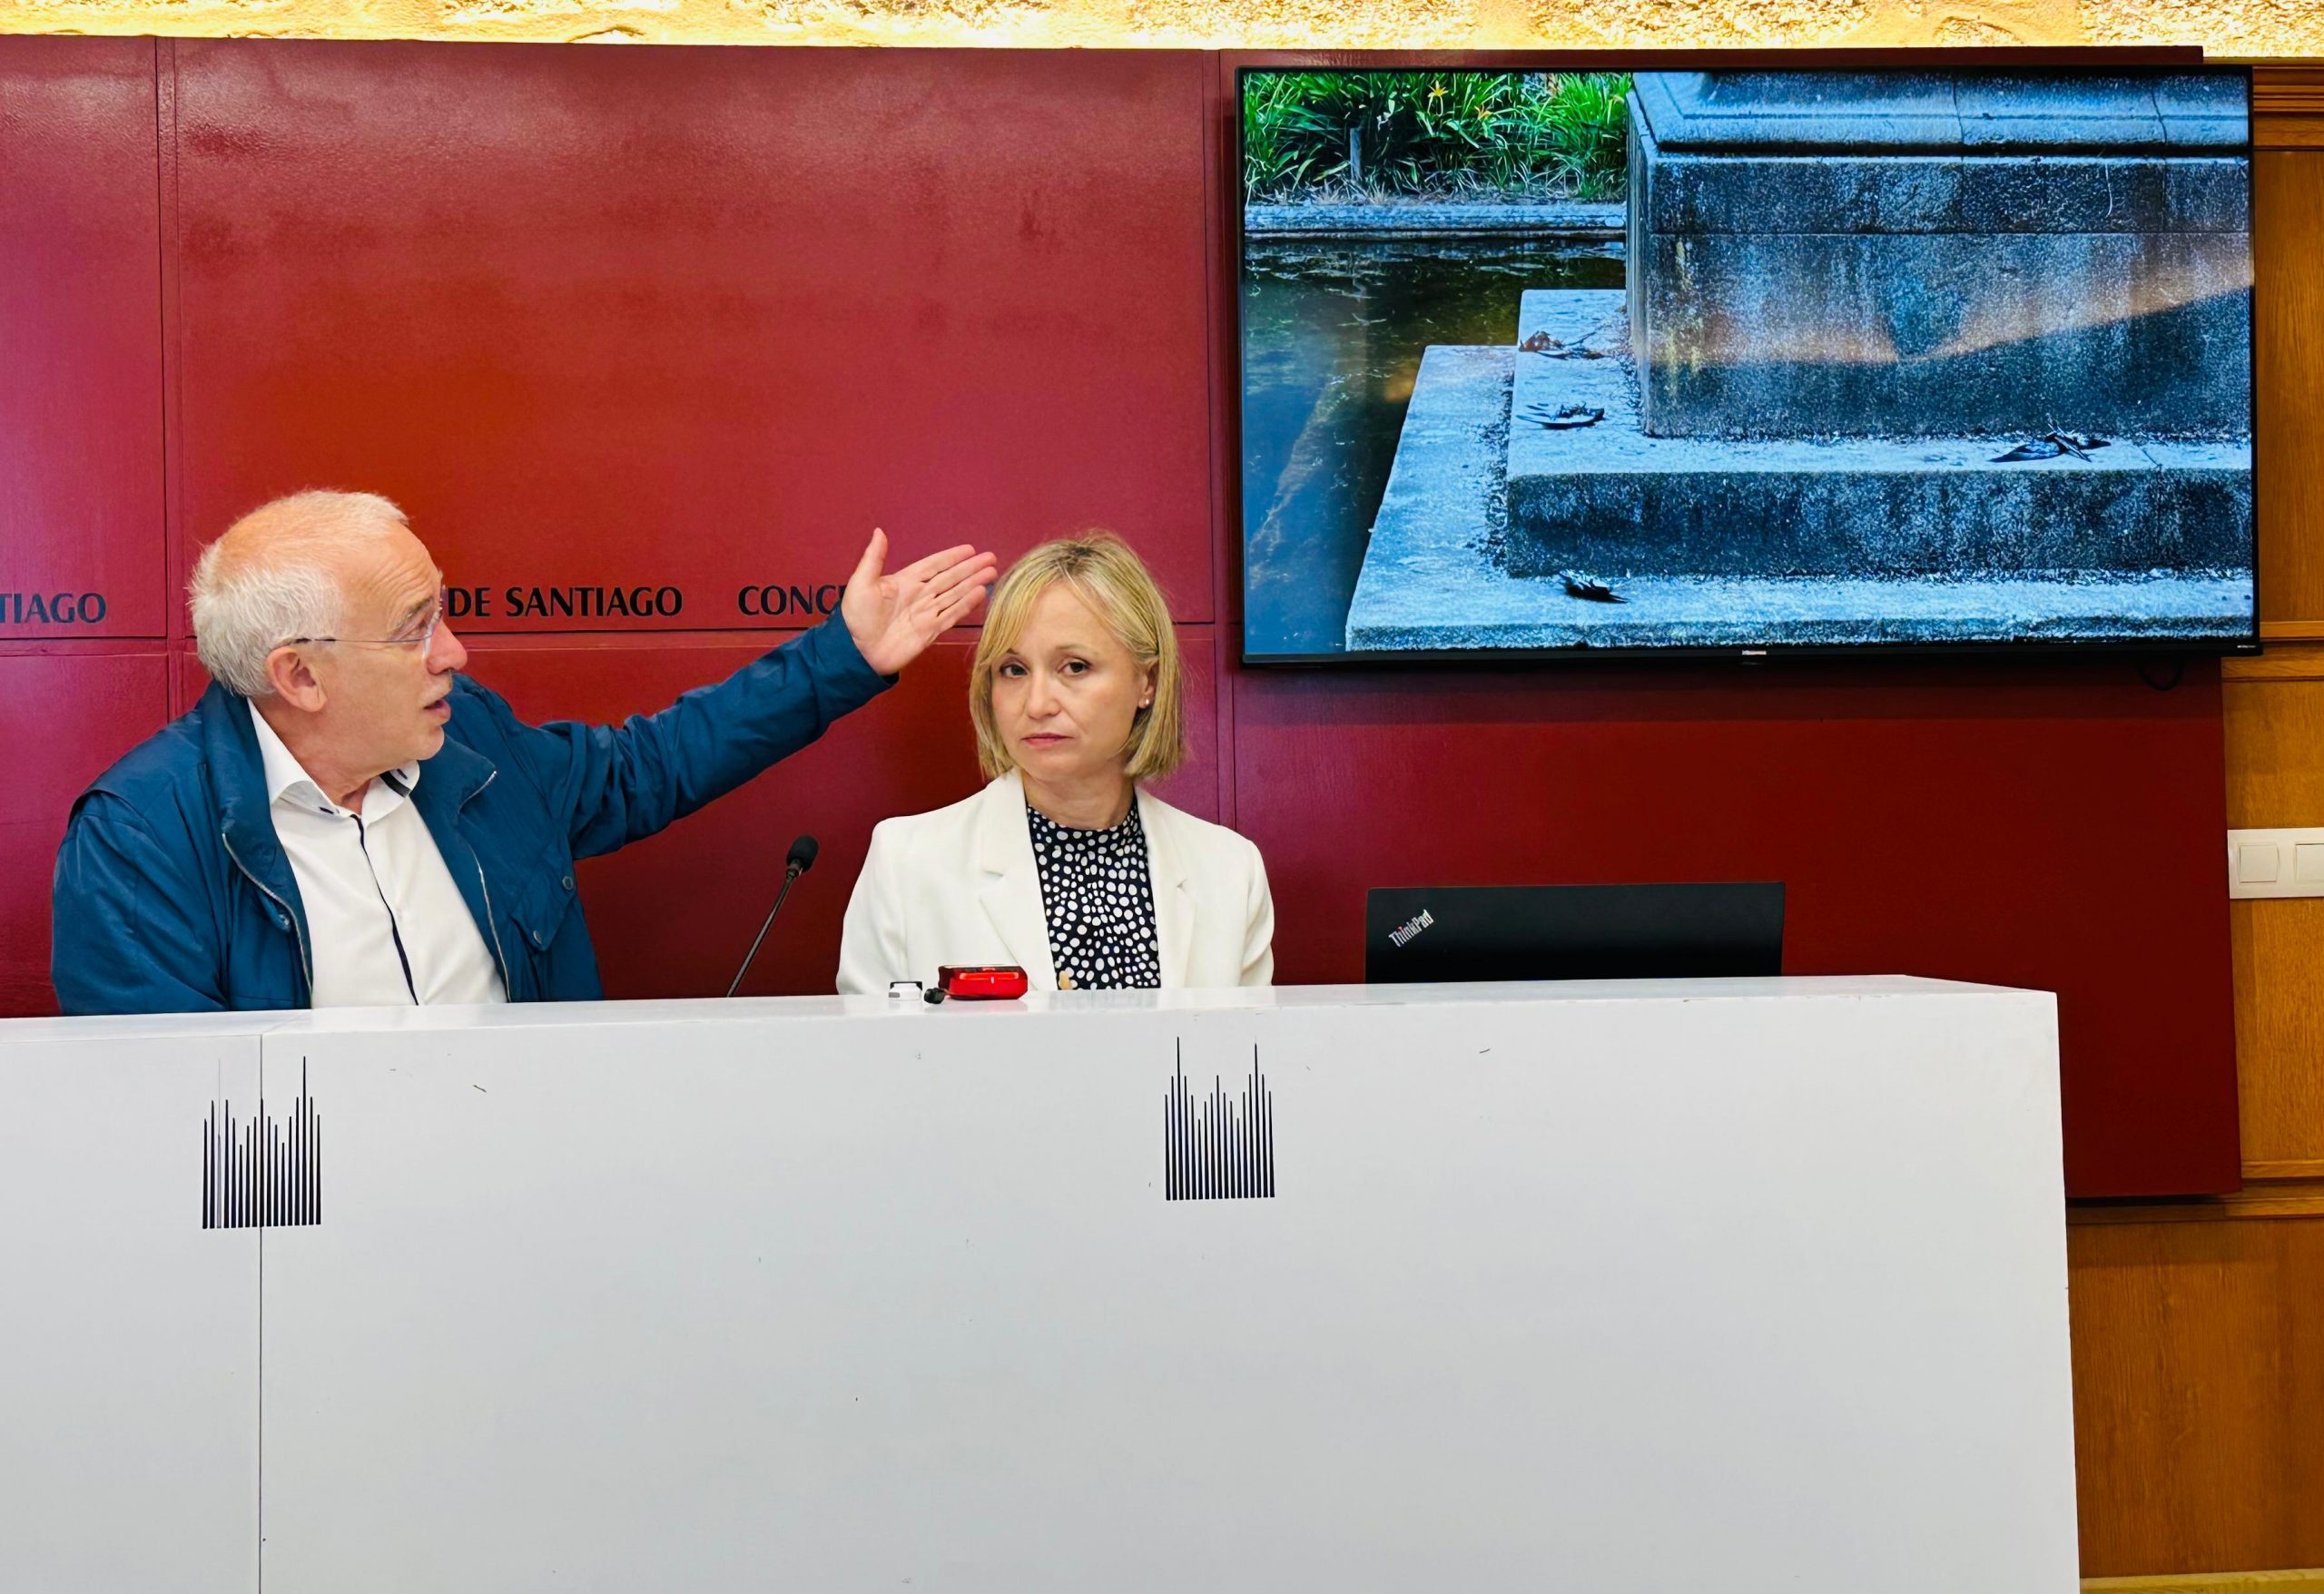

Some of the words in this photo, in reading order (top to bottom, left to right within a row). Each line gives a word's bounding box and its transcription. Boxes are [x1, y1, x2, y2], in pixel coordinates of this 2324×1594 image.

[448, 587, 491, 617] DE
[505, 586, 683, 617] SANTIAGO
[1388, 909, 1434, 948] ThinkPad
